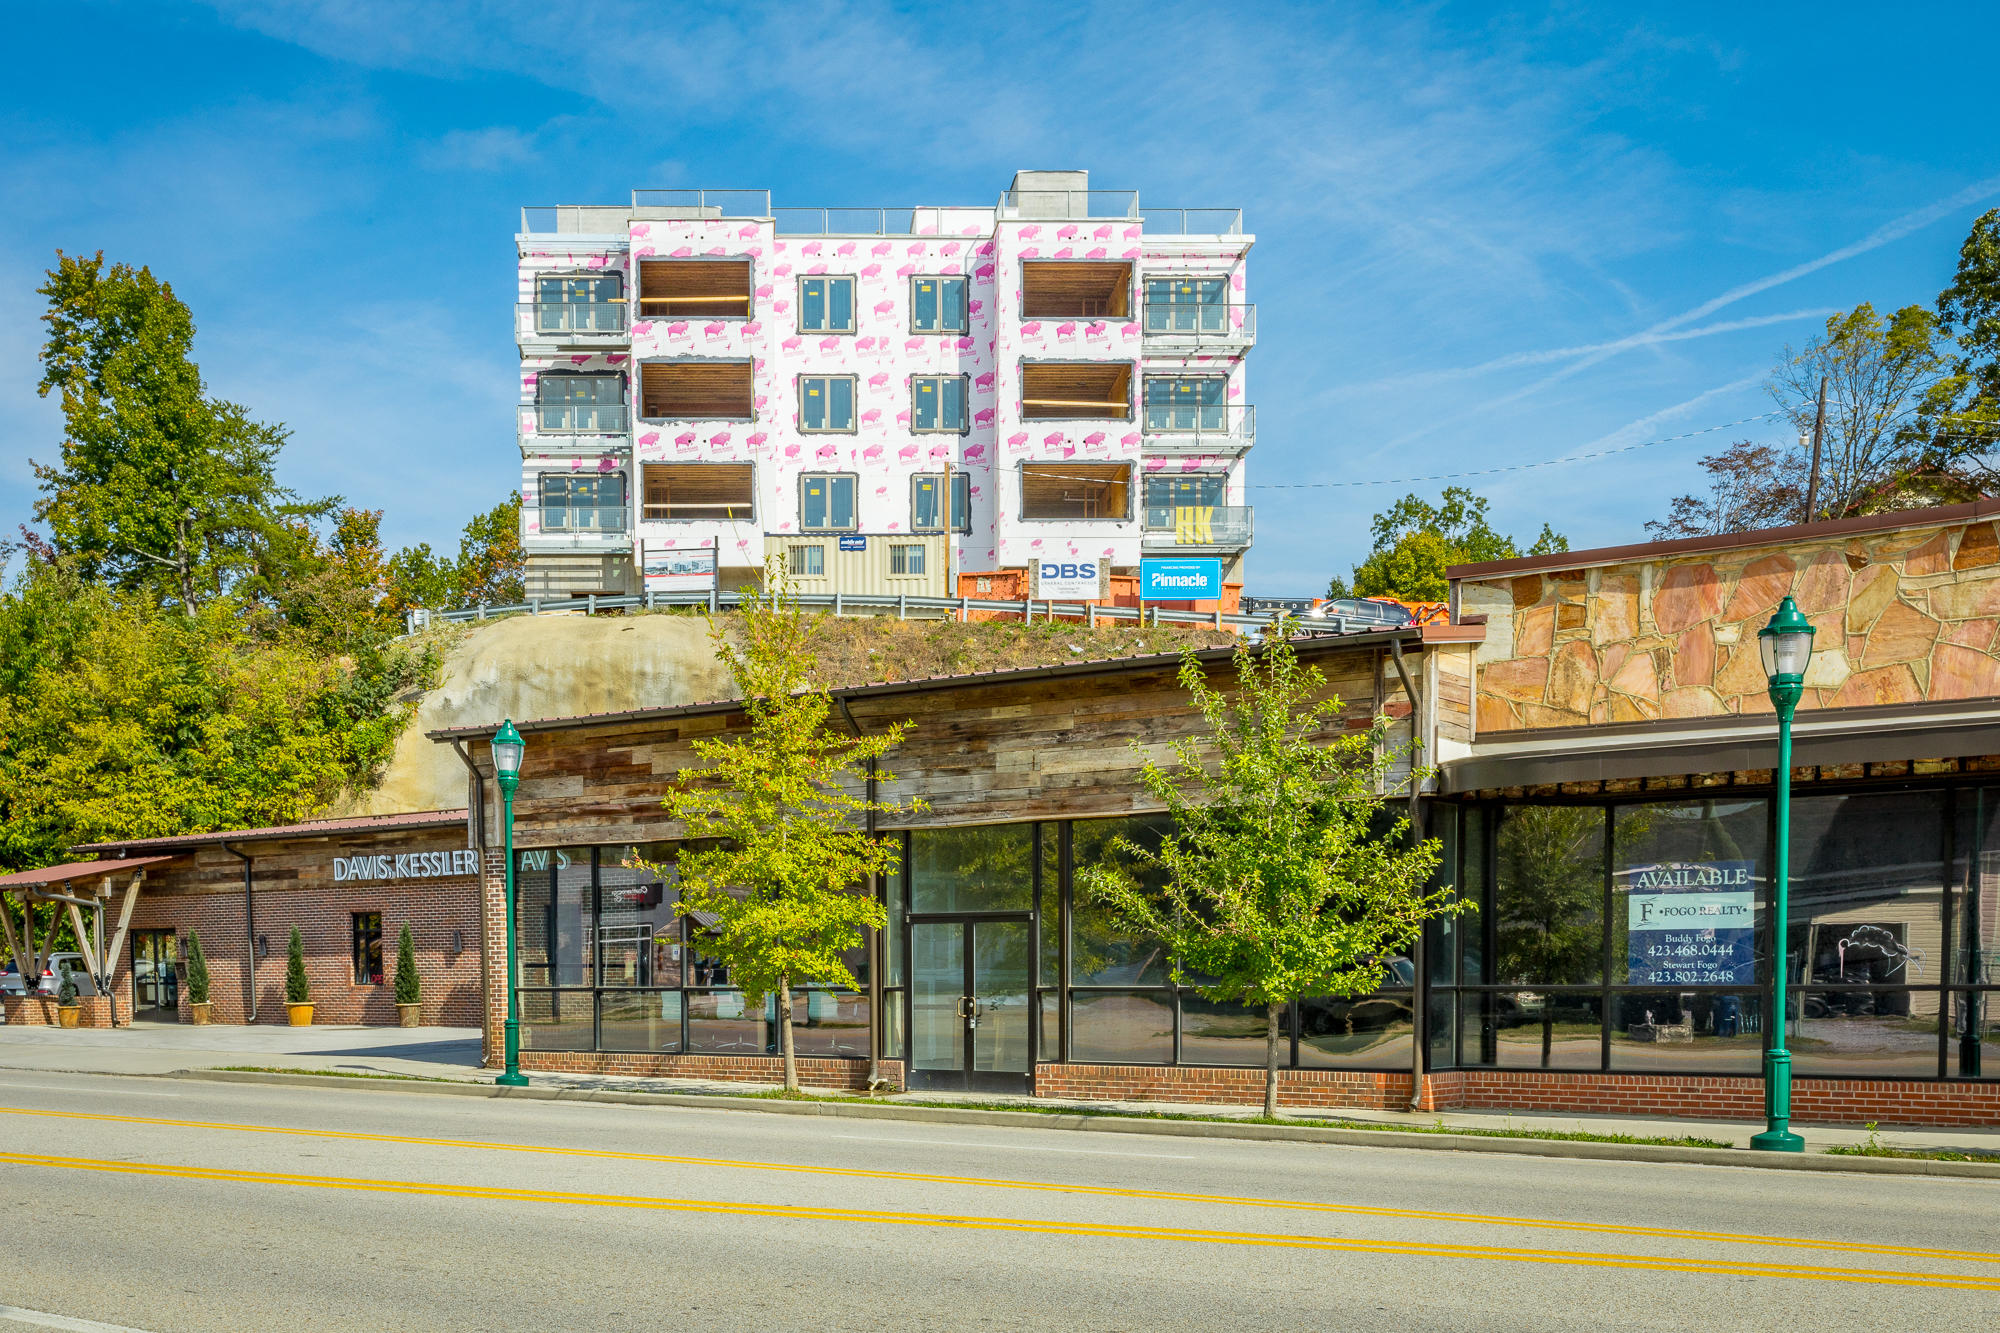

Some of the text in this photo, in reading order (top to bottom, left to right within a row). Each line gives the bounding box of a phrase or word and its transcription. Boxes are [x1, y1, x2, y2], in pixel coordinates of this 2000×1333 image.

[1176, 506, 1214, 544] HK
[1042, 563, 1096, 579] DBS
[1151, 572, 1208, 587] Pinnacle
[333, 850, 478, 881] DAVIS, KESSLER
[1637, 869, 1748, 888] AVAILABLE
[1664, 905, 1742, 916] FOGO REALTY
[1665, 933, 1717, 944] Buddy Fogo
[1647, 944, 1734, 957] 423.468.0444
[1663, 961, 1718, 970] Stewart Fogo
[1647, 971, 1734, 983] 423.802.2648
